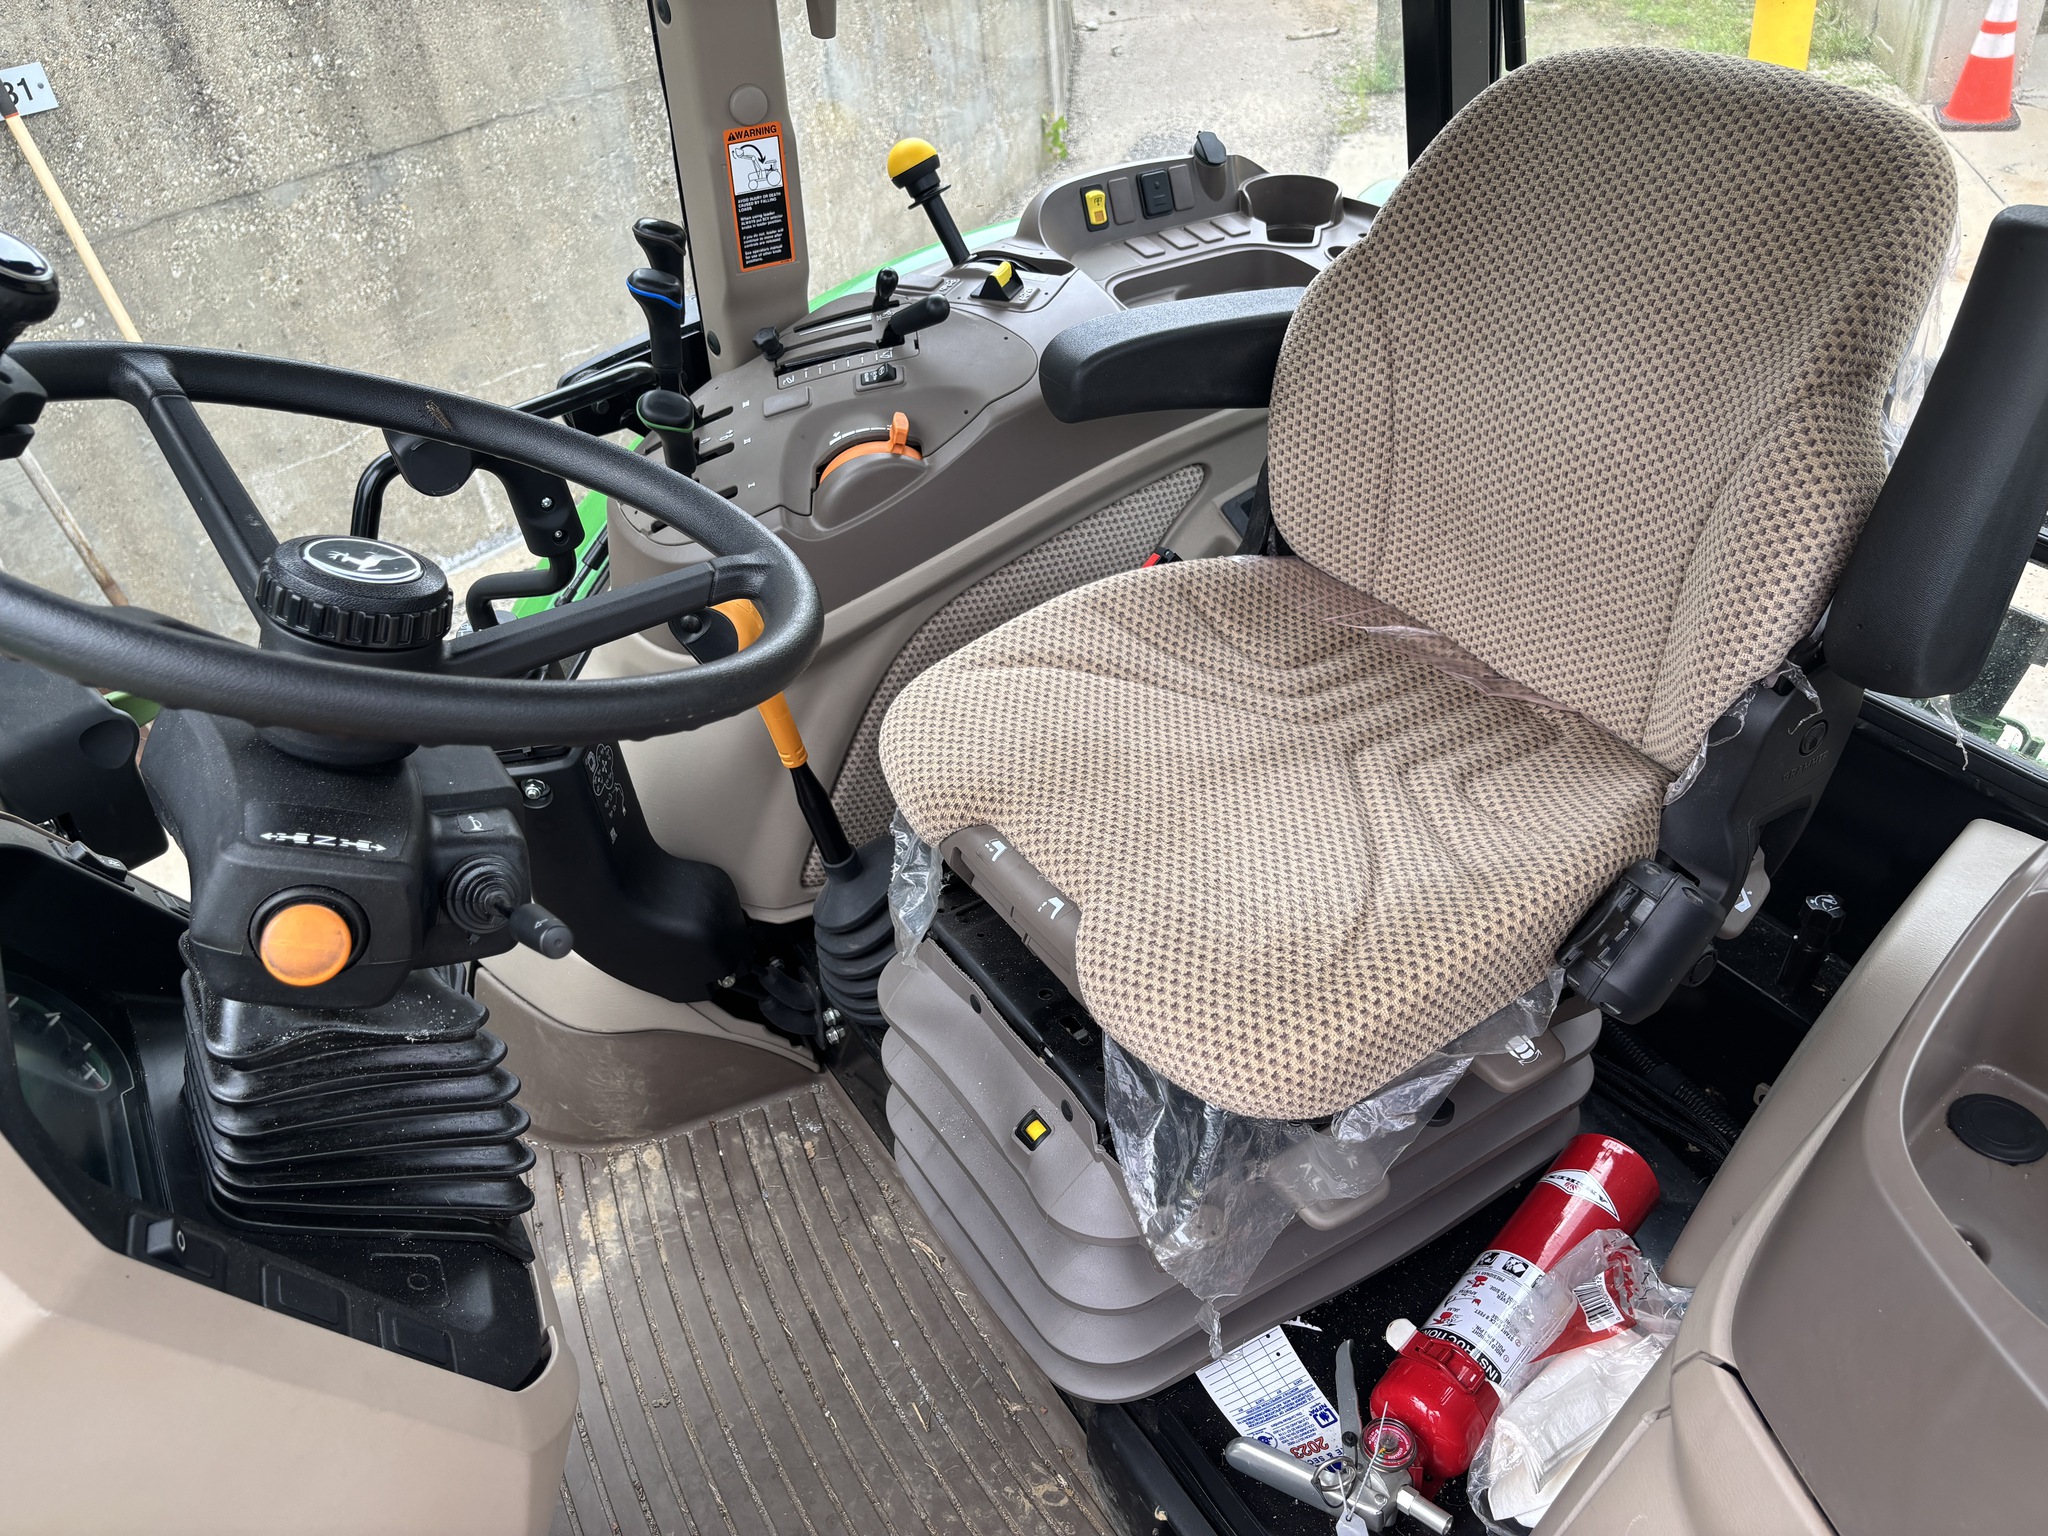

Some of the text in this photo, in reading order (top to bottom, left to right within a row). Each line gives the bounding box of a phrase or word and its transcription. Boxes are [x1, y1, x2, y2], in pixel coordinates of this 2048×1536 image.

[735, 125, 777, 140] WARNING
[1489, 1285, 1501, 1294] SIDE.
[1497, 1294, 1511, 1305] LEVER
[1474, 1309, 1486, 1317] FEET.
[1476, 1325, 1484, 1333] PIN.
[1501, 1328, 1515, 1342] START
[1472, 1329, 1492, 1345] UPIGHT.
[1491, 1344, 1504, 1357] HOLD
[1496, 1341, 1506, 1353] PULL
[1322, 1471, 1376, 1502] 2023
[1371, 1492, 1380, 1502] &
